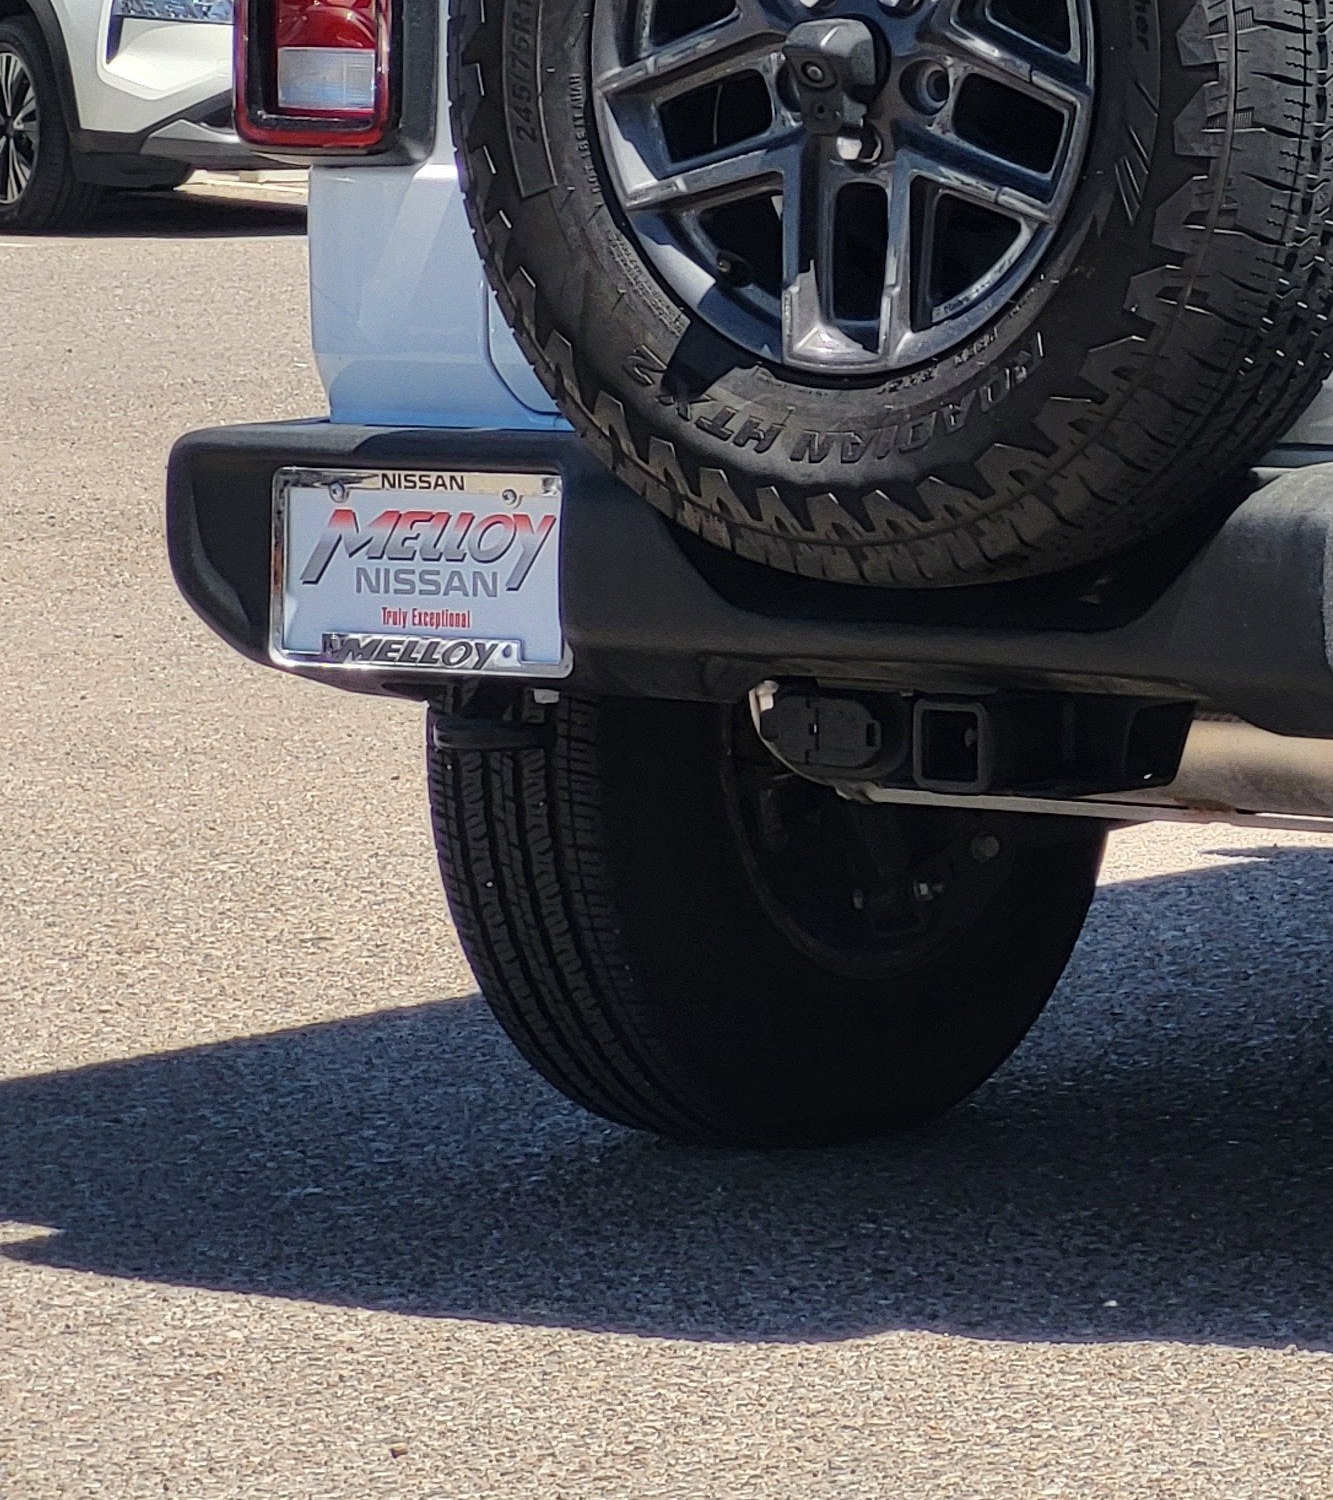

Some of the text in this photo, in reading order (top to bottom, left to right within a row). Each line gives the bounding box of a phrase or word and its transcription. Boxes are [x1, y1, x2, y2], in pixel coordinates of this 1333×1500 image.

[380, 472, 465, 491] NISSAN
[300, 508, 557, 592] MELLOY
[355, 567, 498, 598] NISSAN
[380, 606, 472, 630] Truly Exceptional
[335, 637, 500, 670] MELLOY
